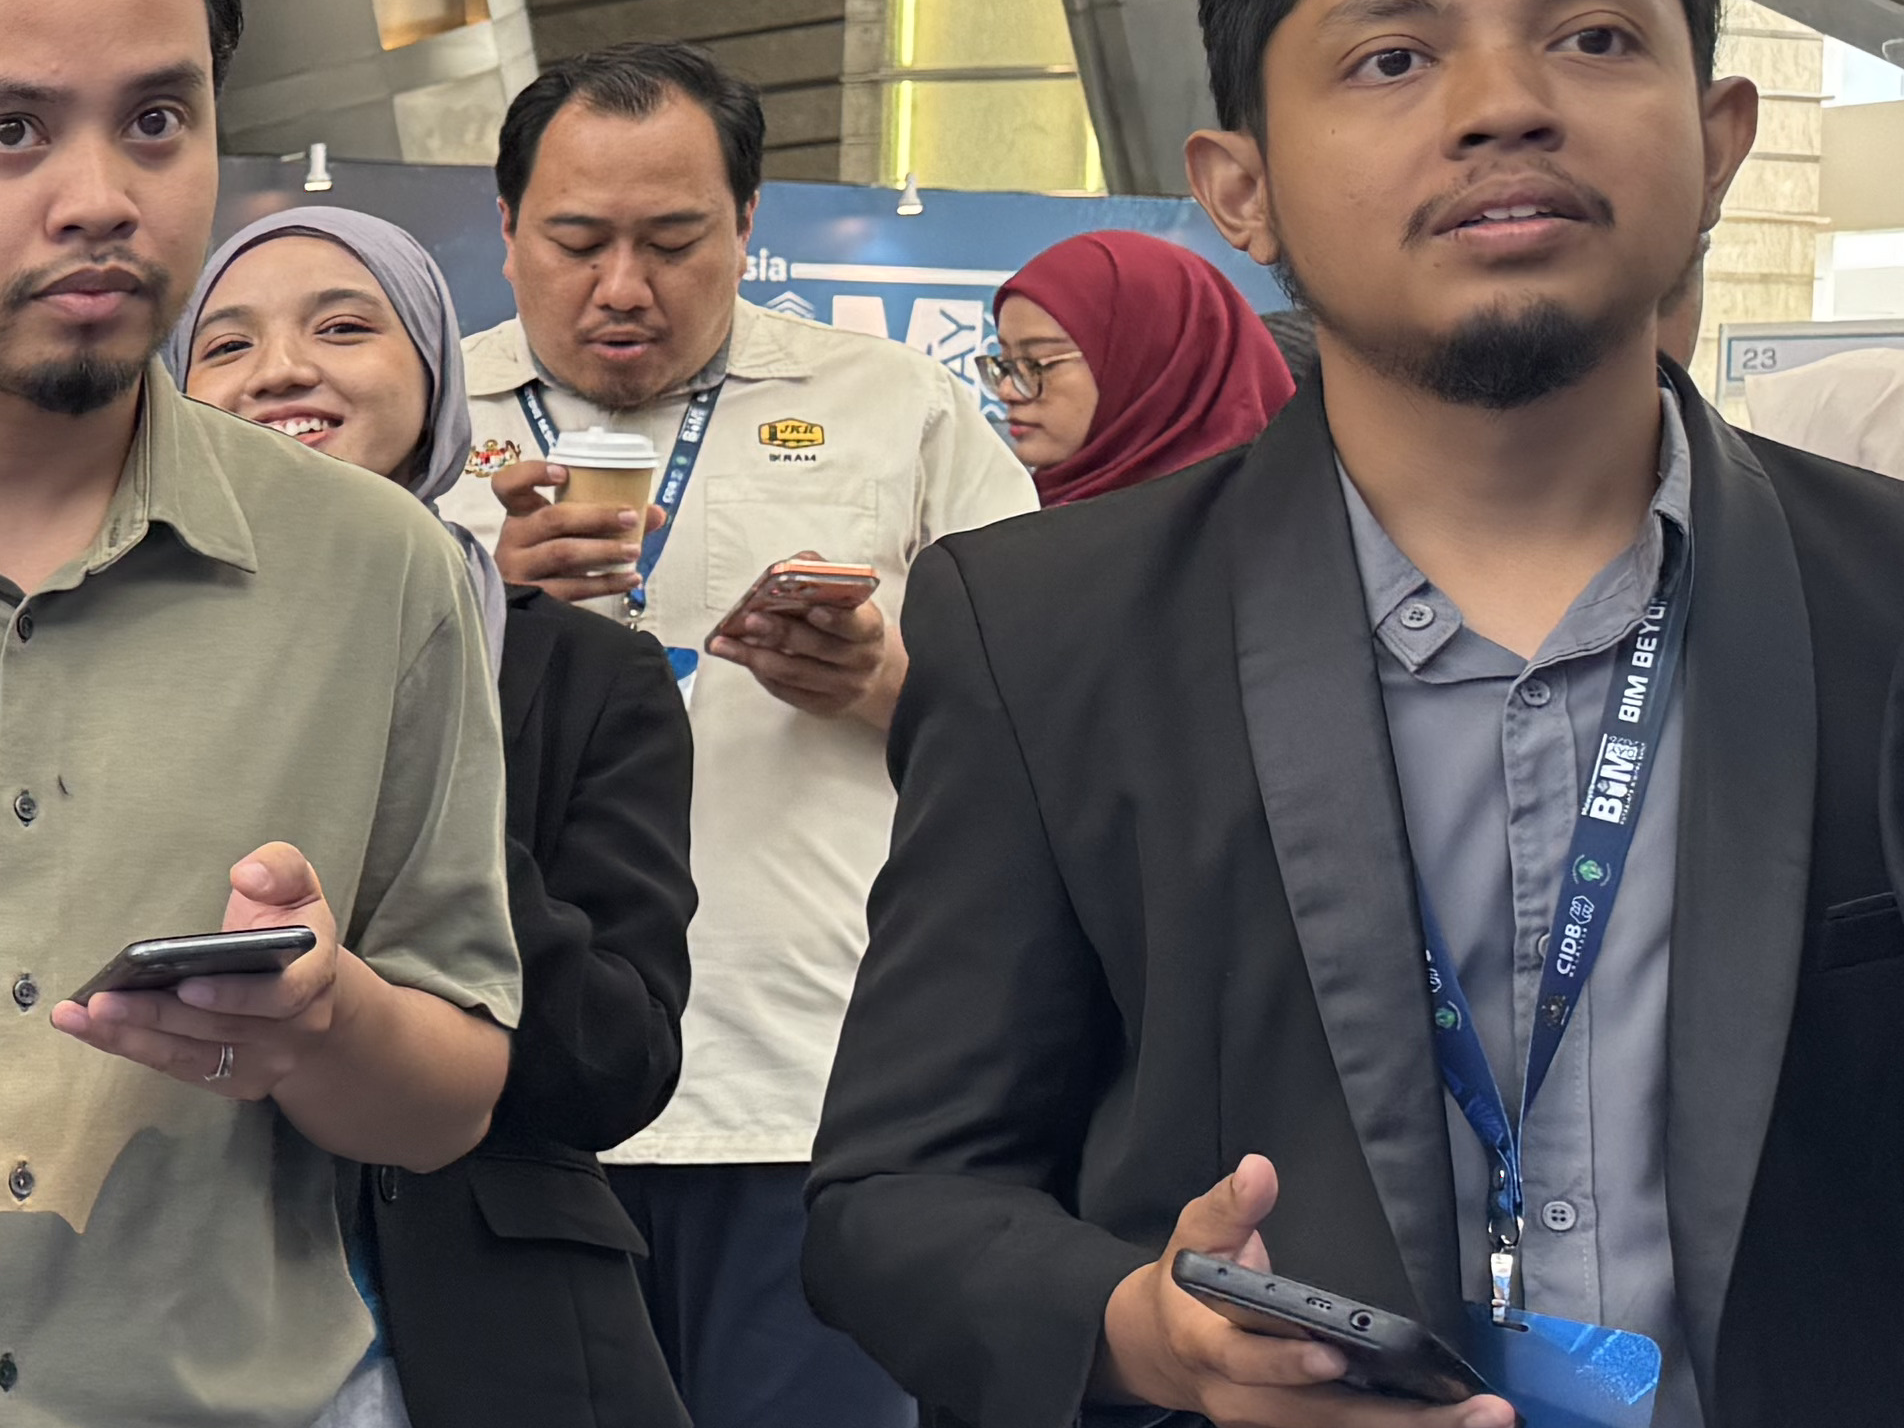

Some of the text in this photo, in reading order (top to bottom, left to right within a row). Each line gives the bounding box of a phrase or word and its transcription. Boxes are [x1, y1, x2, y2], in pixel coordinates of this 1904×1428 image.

[742, 247, 788, 282] sia
[1743, 347, 1778, 370] 23
[1618, 674, 1649, 723] BIM
[1557, 924, 1581, 974] CIDB
